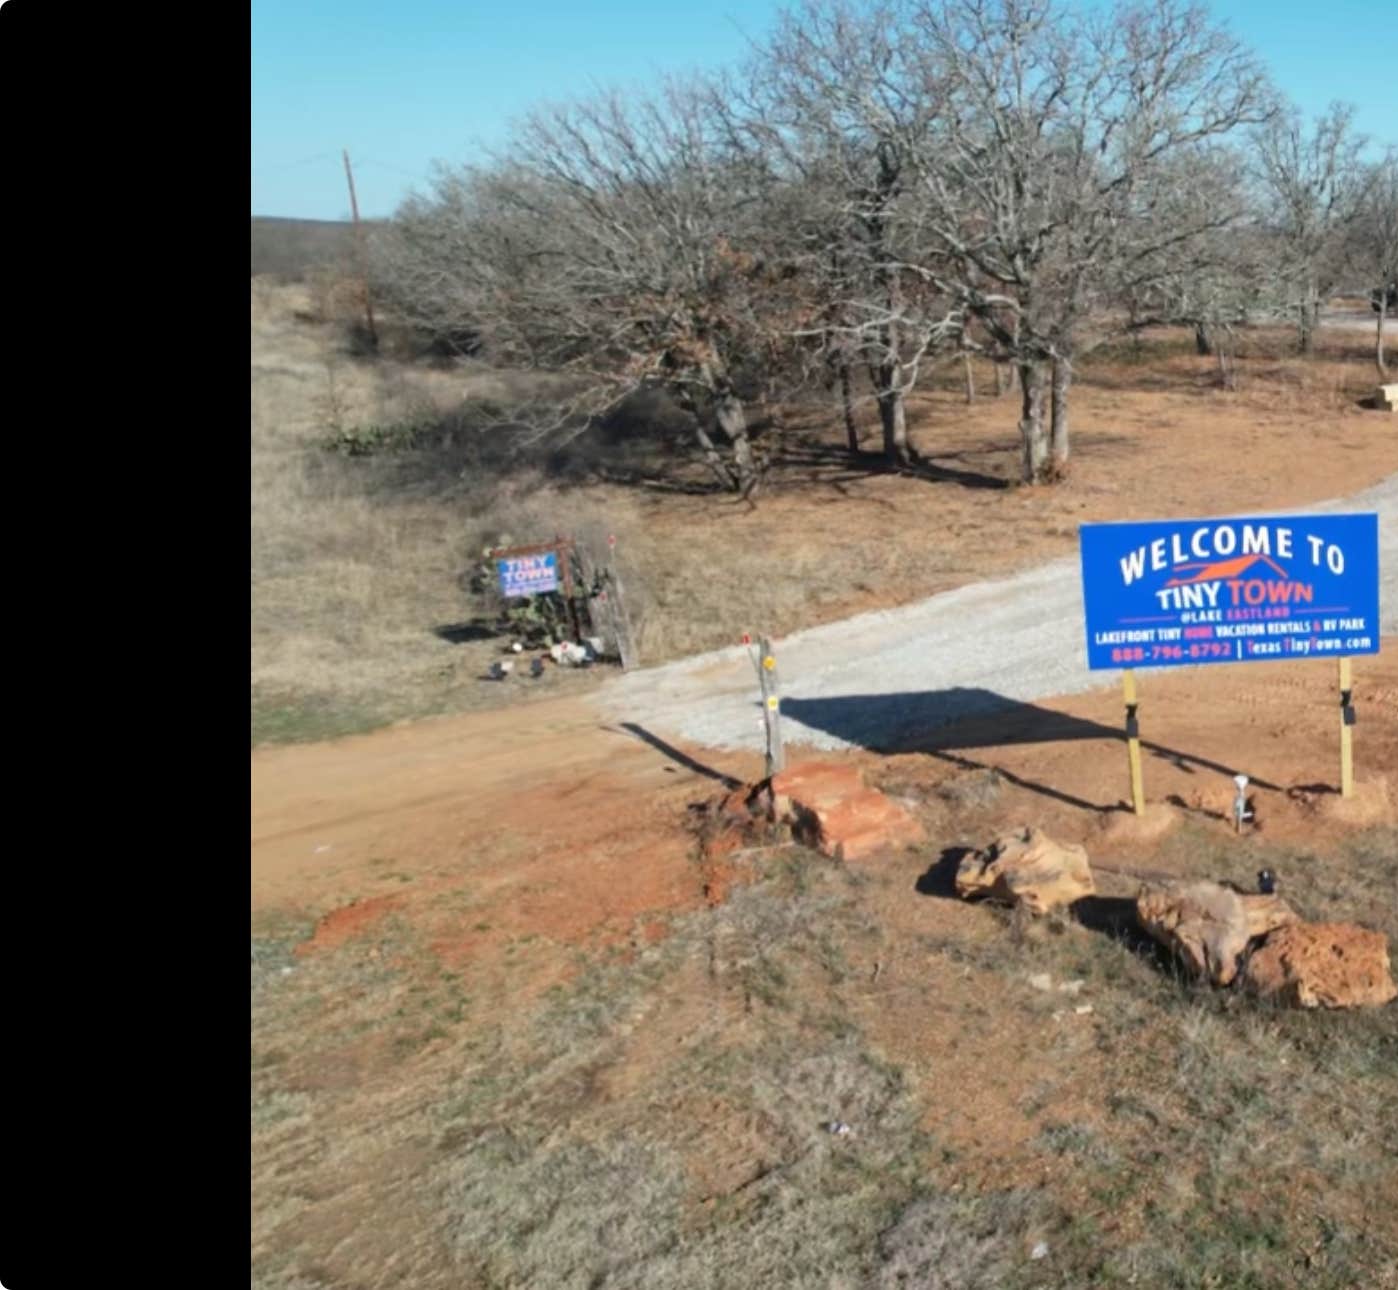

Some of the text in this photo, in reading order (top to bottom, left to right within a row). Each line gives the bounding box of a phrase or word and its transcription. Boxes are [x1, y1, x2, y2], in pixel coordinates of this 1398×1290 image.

[507, 557, 546, 572] TINY
[1120, 525, 1345, 586] WELCOME TO
[502, 569, 555, 582] TOWN
[1156, 579, 1313, 610] TINY TOWN
[1180, 607, 1290, 623] @LAKE EASTLAND
[1096, 629, 1155, 645] LAKEFRONT
[1158, 627, 1181, 641] TINY
[1216, 623, 1265, 638] VACATION
[1267, 621, 1310, 635] RENTALS
[1323, 620, 1337, 632] RV
[1339, 618, 1365, 631] PARK
[1112, 642, 1231, 662] 888-796-8792
